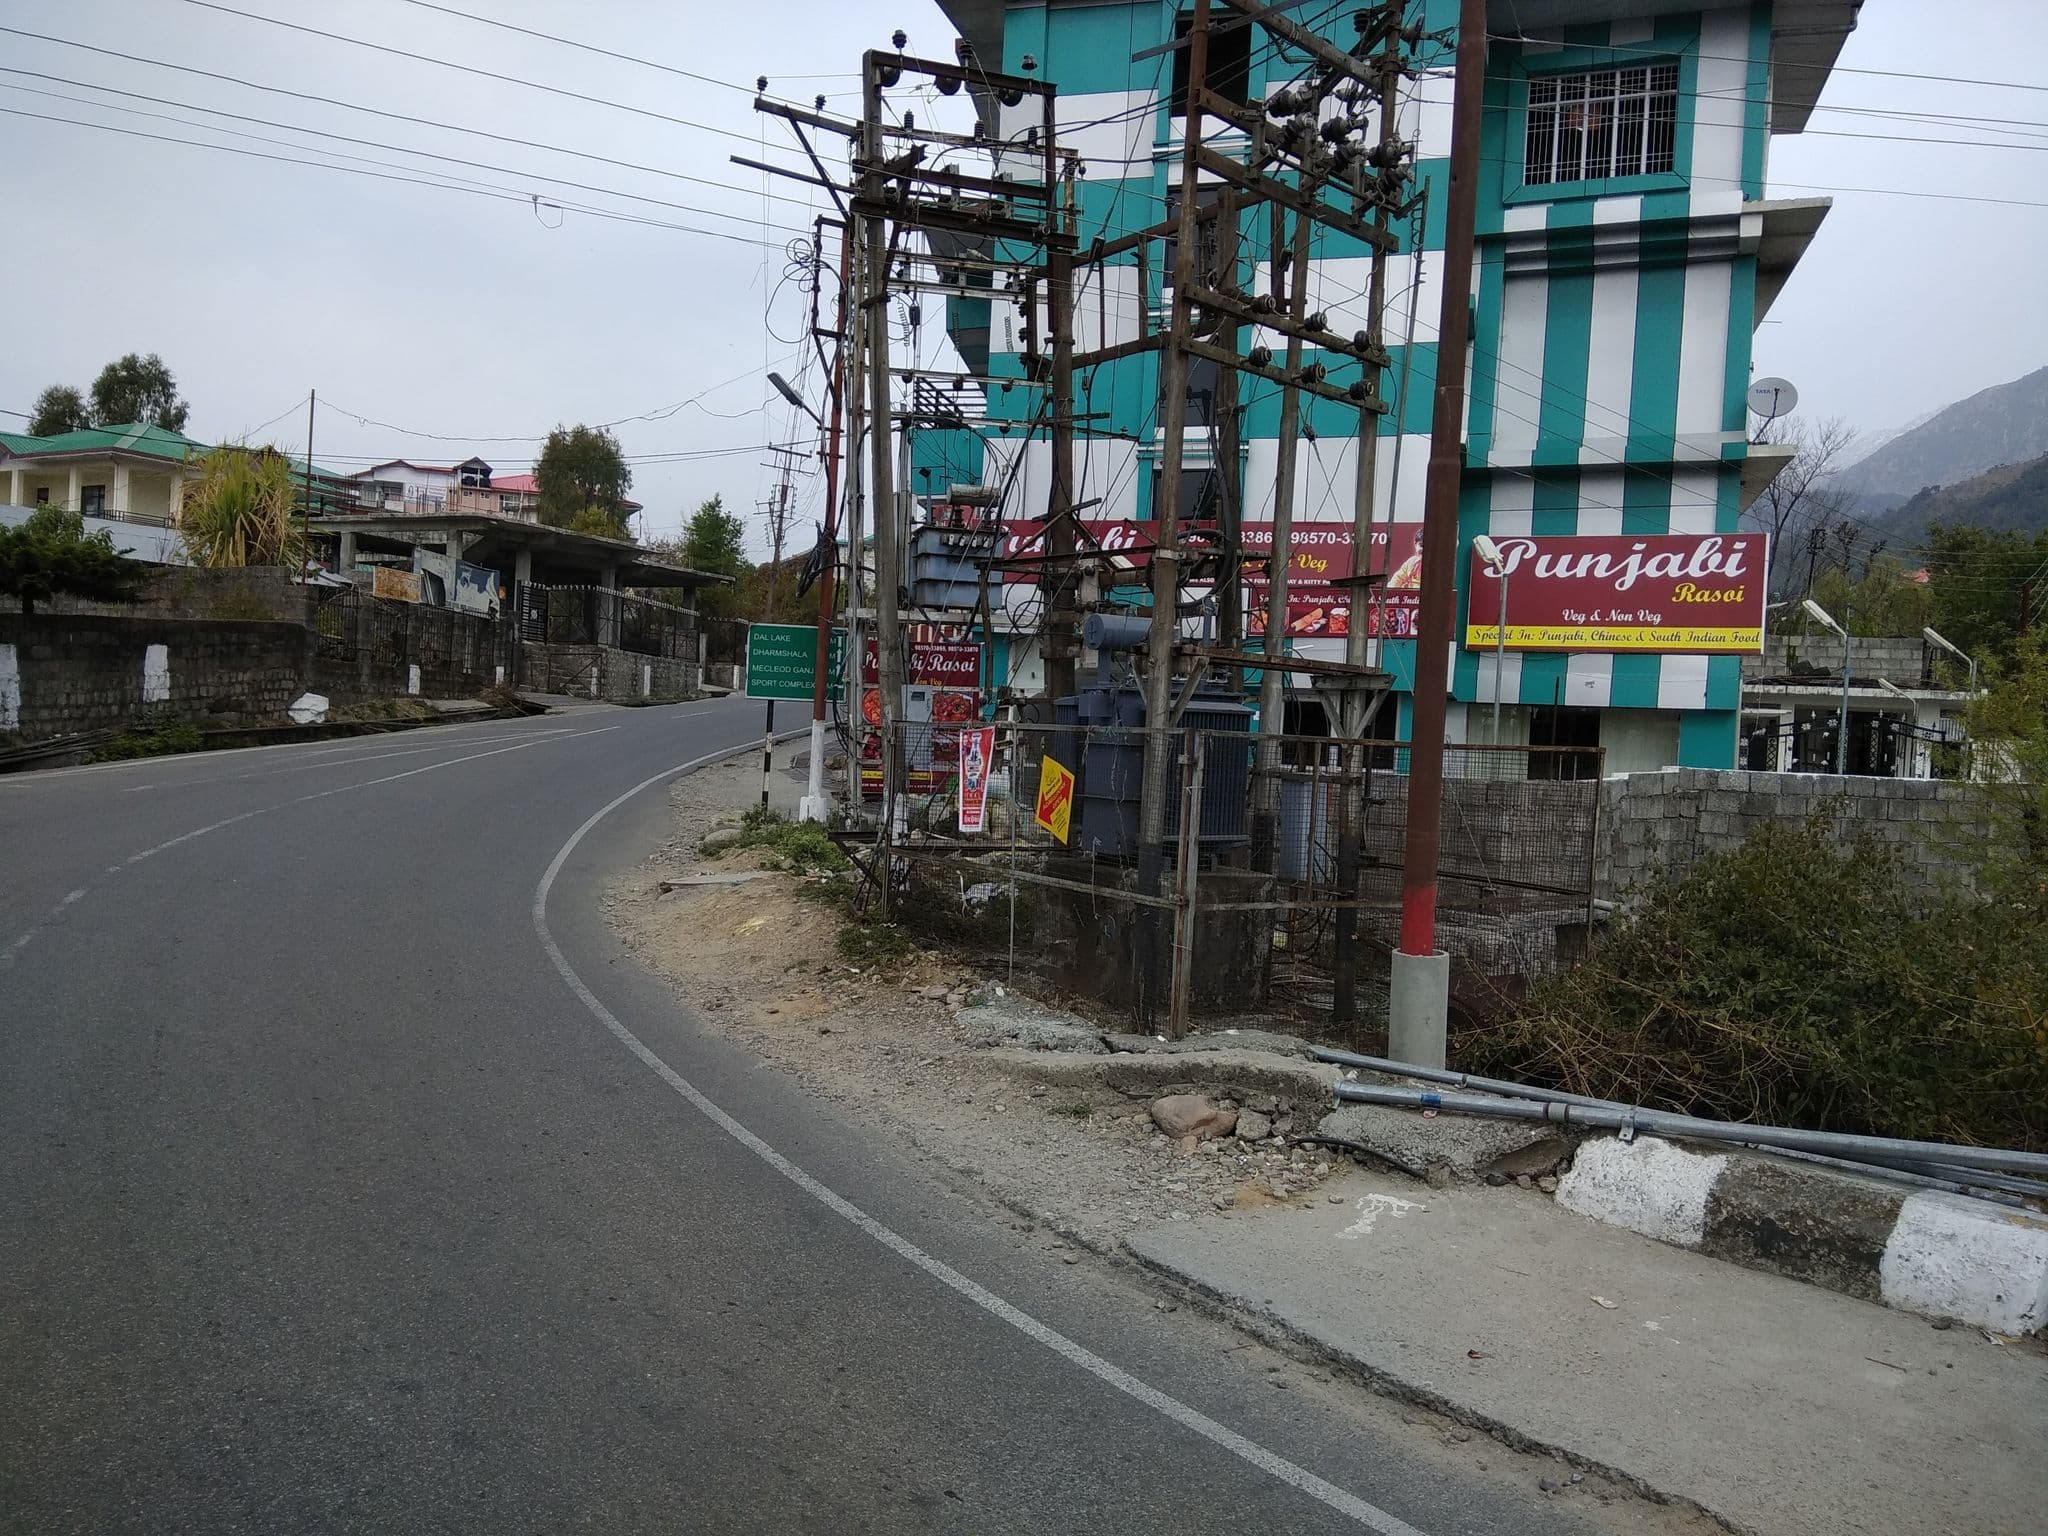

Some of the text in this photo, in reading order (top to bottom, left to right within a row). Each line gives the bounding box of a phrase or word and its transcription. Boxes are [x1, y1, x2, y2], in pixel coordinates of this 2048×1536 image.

[1290, 532, 1388, 544] 98570-370
[1297, 553, 1329, 573] Veg
[1483, 536, 1747, 591] Punjabi
[1671, 582, 1745, 602] Rasoi
[1302, 594, 1337, 605] Punjabi,
[1562, 609, 1662, 624] Veg & Non Veg
[753, 632, 769, 641] DAL
[770, 634, 791, 642] LAKE
[1474, 628, 1760, 644] Specal In: Punjabi, Chinese & South Indian Food
[752, 648, 808, 658] DHARMSHALA
[752, 664, 792, 673] MECLEOD
[792, 666, 815, 674] GANJ
[927, 653, 976, 672] Rasoi
[751, 678, 777, 687] SPORT
[778, 680, 816, 689] COMPLEX
